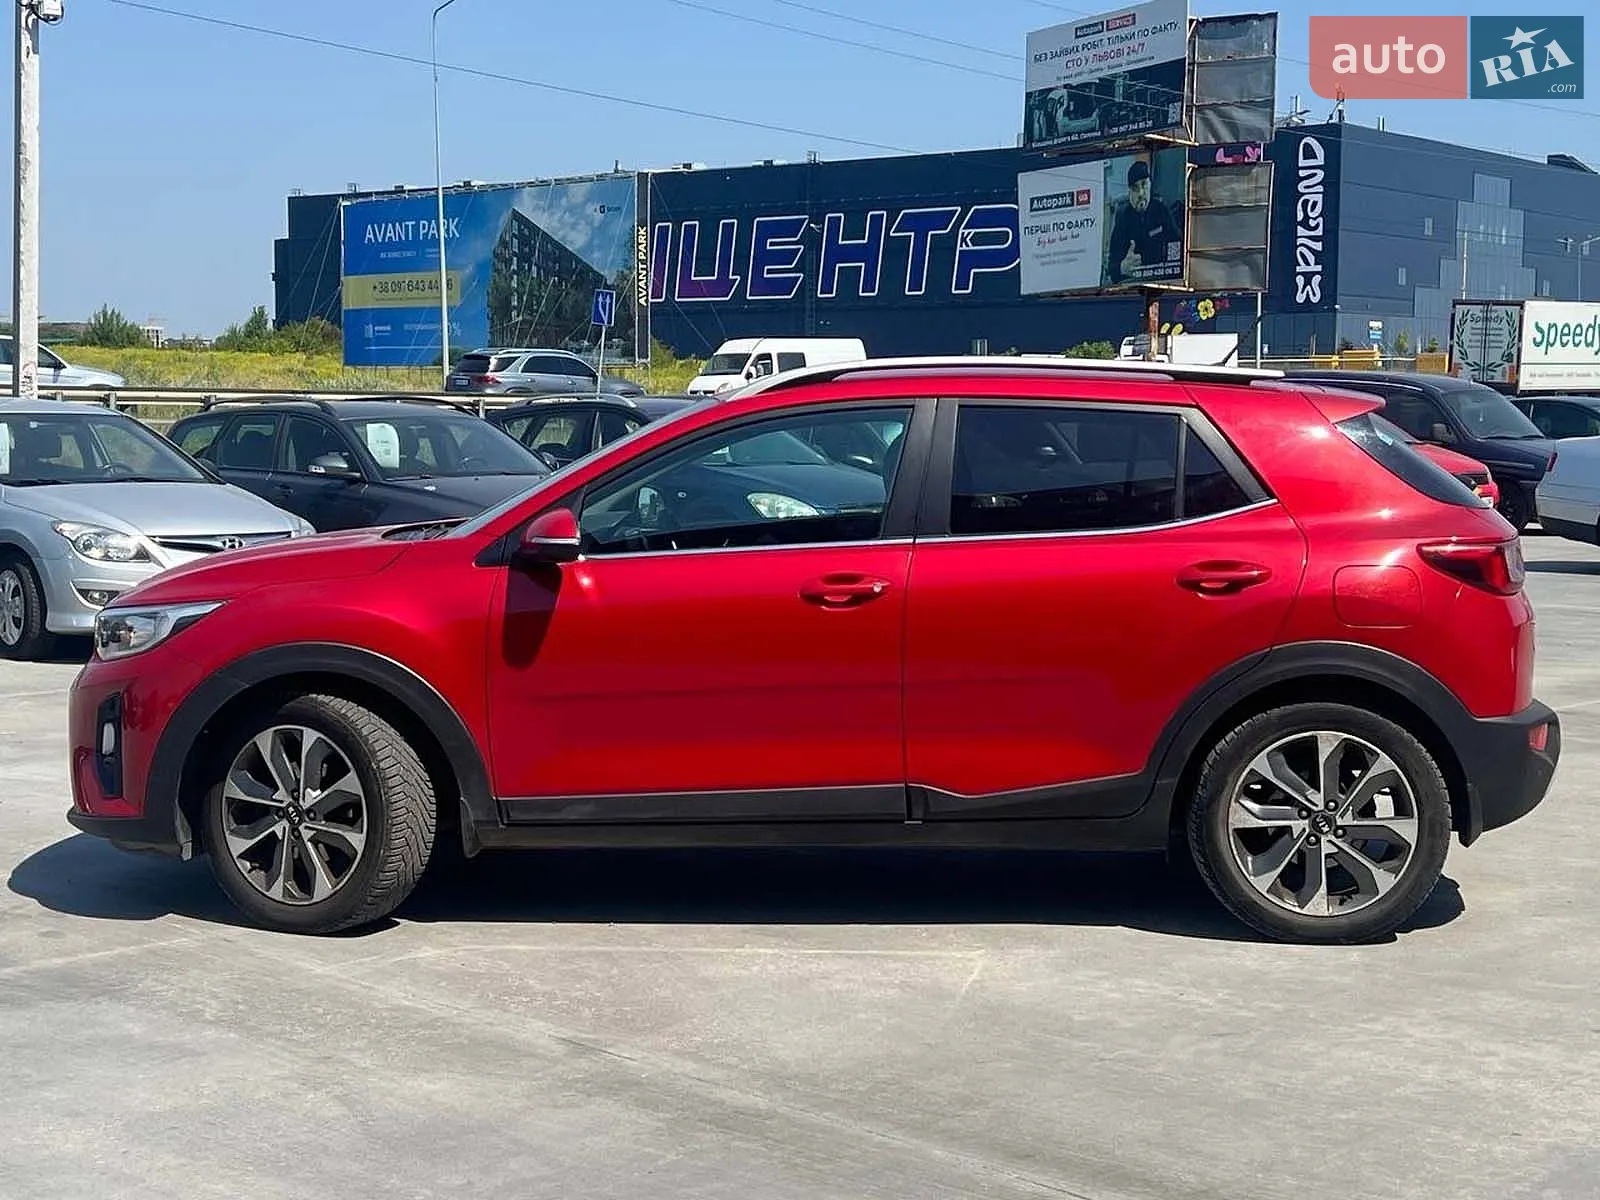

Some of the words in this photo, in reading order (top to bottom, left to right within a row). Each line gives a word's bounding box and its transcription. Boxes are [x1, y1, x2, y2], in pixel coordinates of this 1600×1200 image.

[1032, 192, 1073, 210] Autopark
[364, 221, 416, 244] AVANT
[420, 217, 460, 241] PARK
[1024, 223, 1051, 236] ПЕРШІ
[1052, 221, 1065, 233] ПО
[638, 225, 647, 260] PARK
[638, 262, 647, 307] AVANT
[1470, 313, 1505, 326] Spedy
